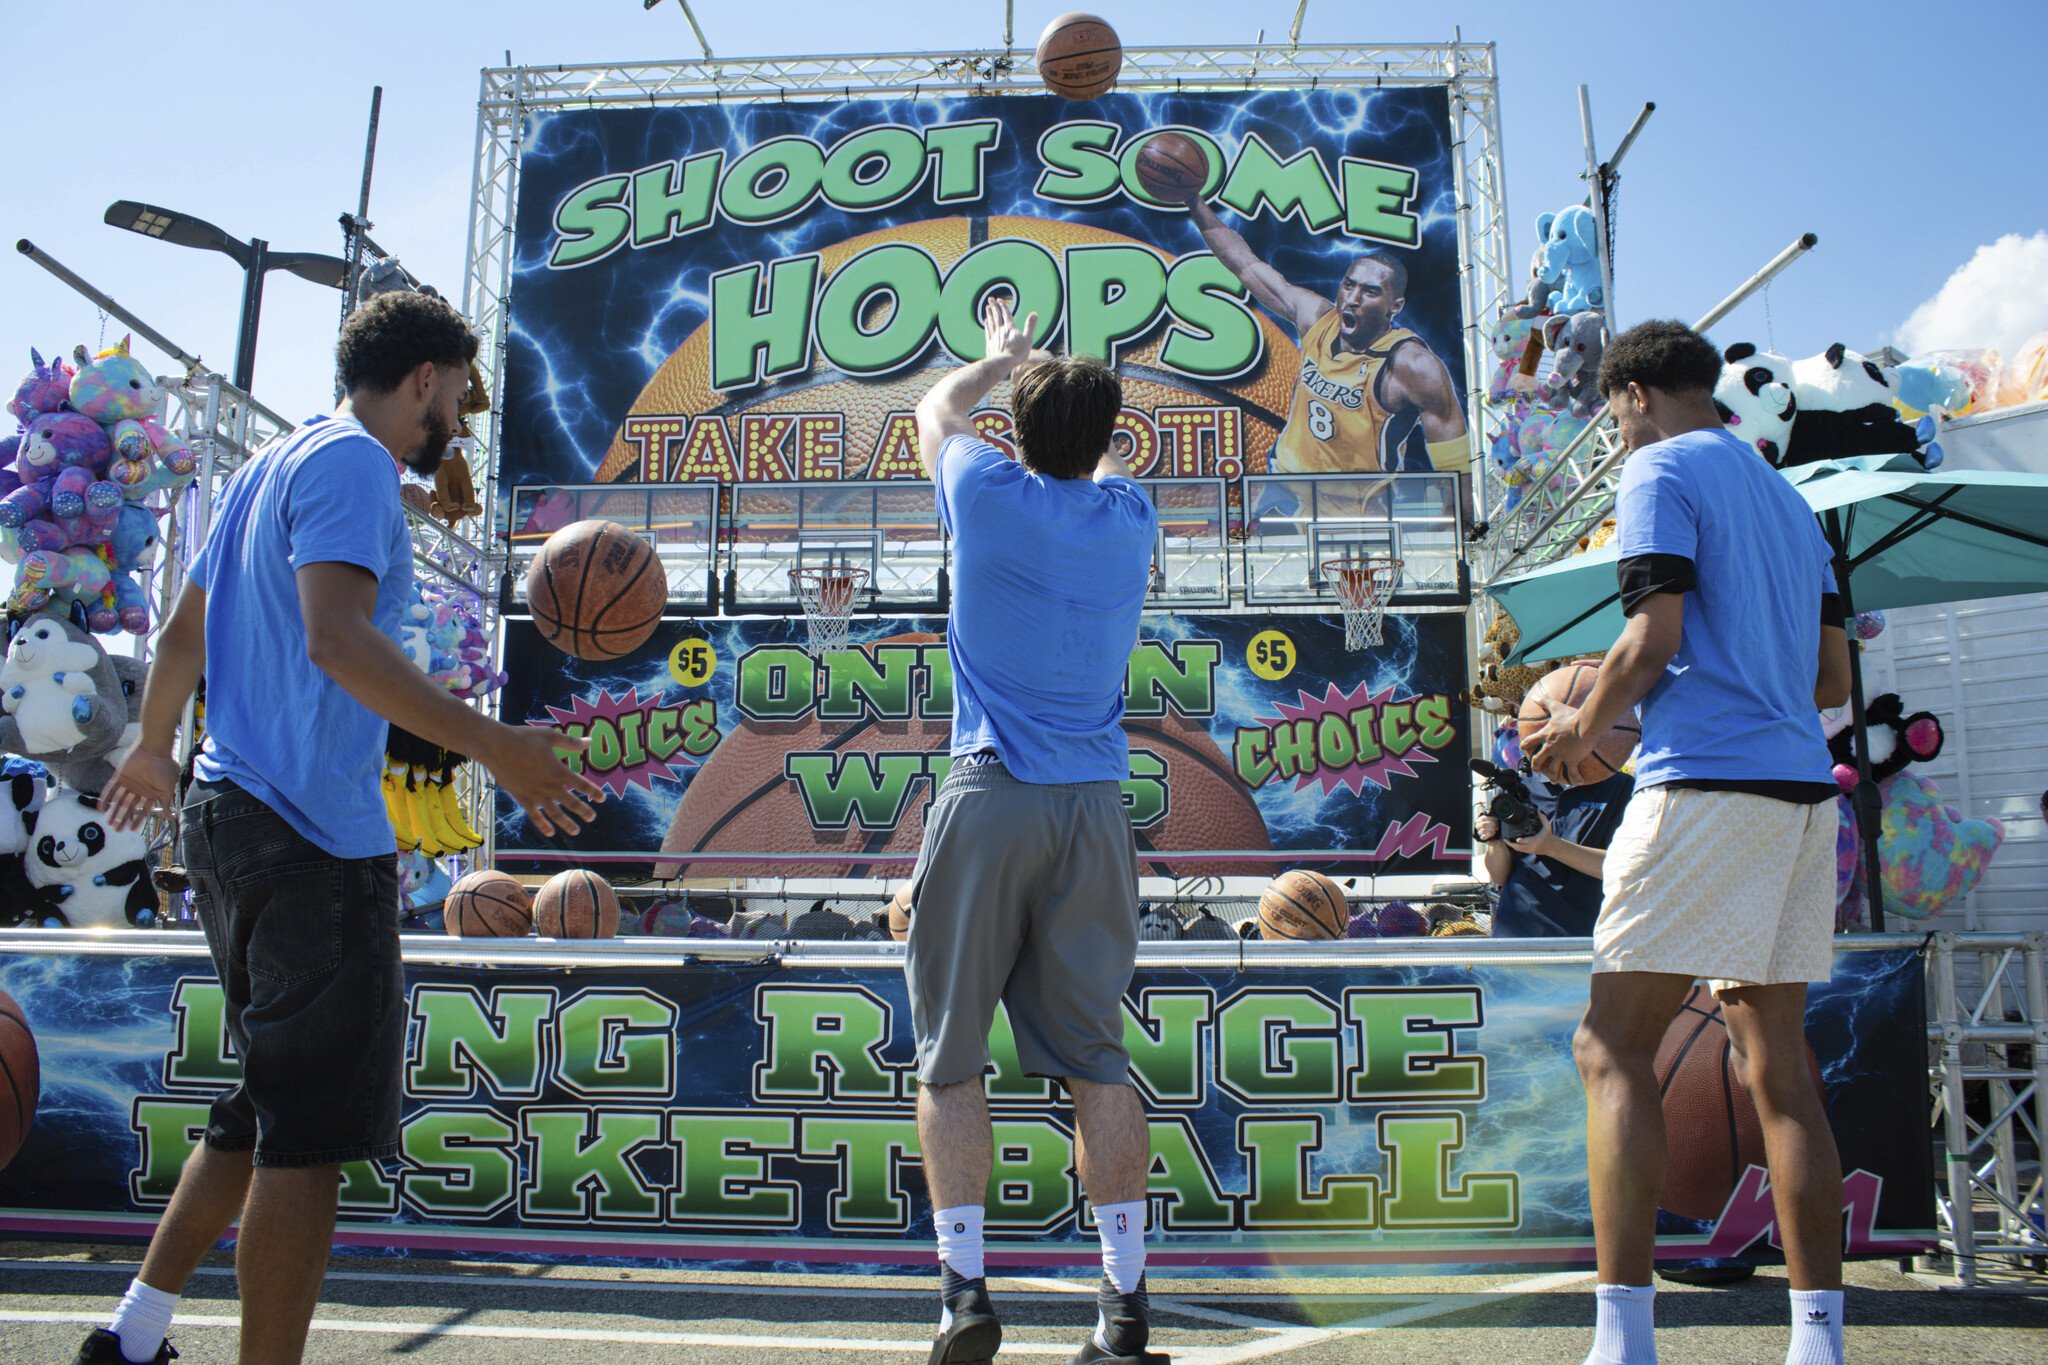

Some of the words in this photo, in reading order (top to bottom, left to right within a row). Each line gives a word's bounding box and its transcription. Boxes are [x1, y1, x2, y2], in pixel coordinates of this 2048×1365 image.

[547, 119, 1001, 269] SHOOT
[1033, 119, 1422, 249] SOME
[709, 237, 1263, 394] HOOPS
[624, 411, 846, 483] TAKE
[868, 408, 936, 482] A
[1308, 400, 1334, 441] 8
[1179, 586, 1217, 595] SPALDING
[677, 647, 708, 679] $5
[1255, 639, 1288, 672] $5
[1232, 694, 1457, 789] CHOICE
[162, 977, 681, 1101] LNG
